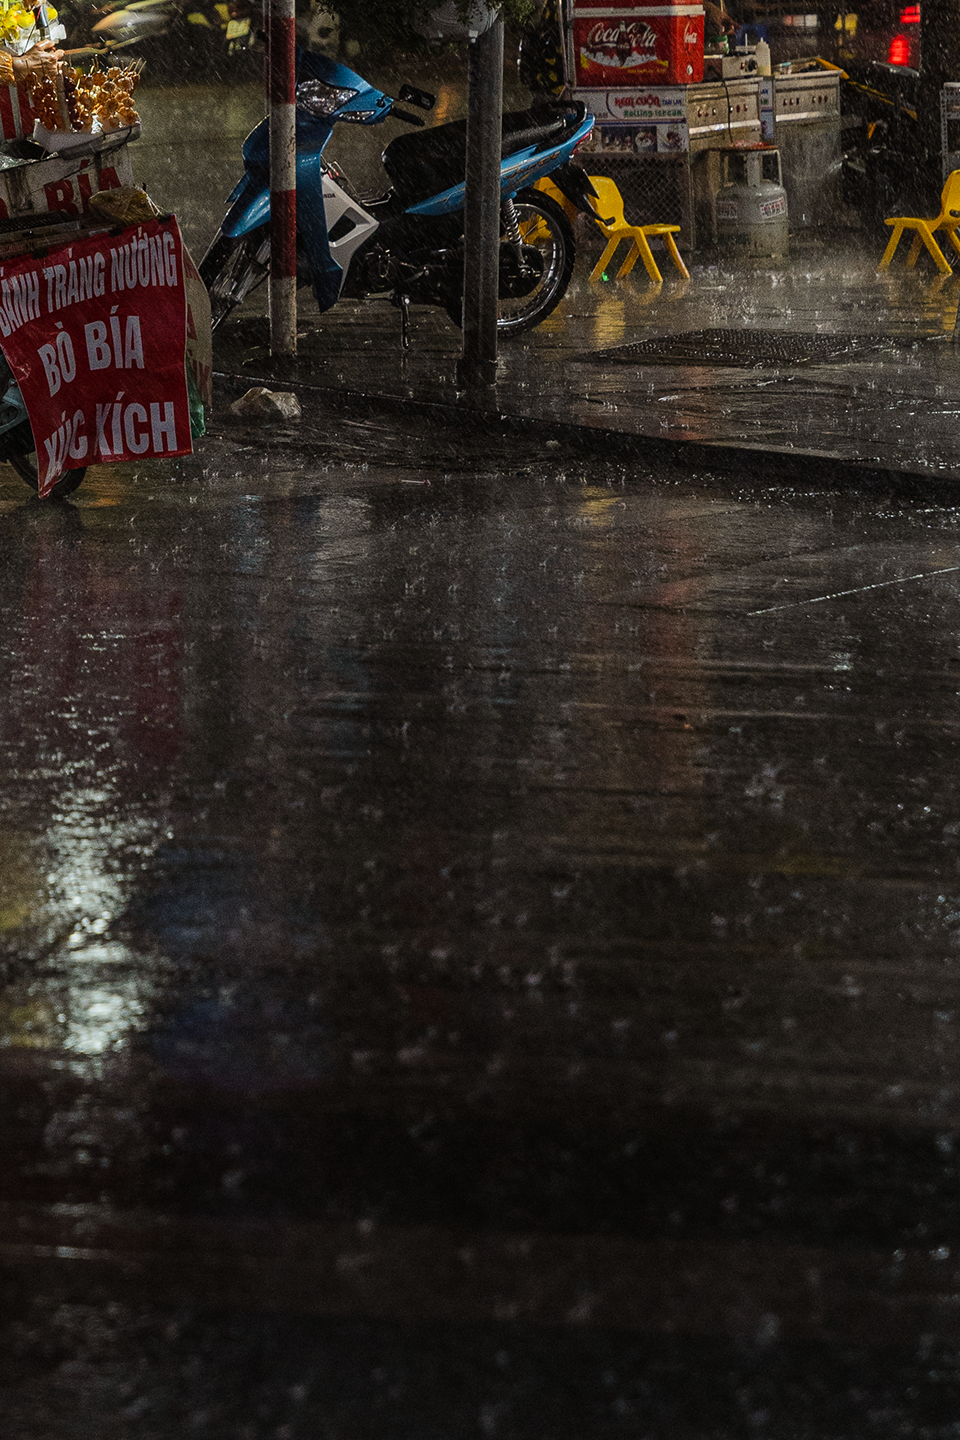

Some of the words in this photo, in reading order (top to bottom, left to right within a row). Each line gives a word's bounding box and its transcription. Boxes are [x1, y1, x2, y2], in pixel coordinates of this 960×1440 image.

[43, 247, 106, 313] TRÁNG
[110, 227, 178, 292] NƯỚNG
[37, 321, 77, 398] BÒ
[84, 305, 145, 371] BÍA
[43, 409, 89, 487] XÚC
